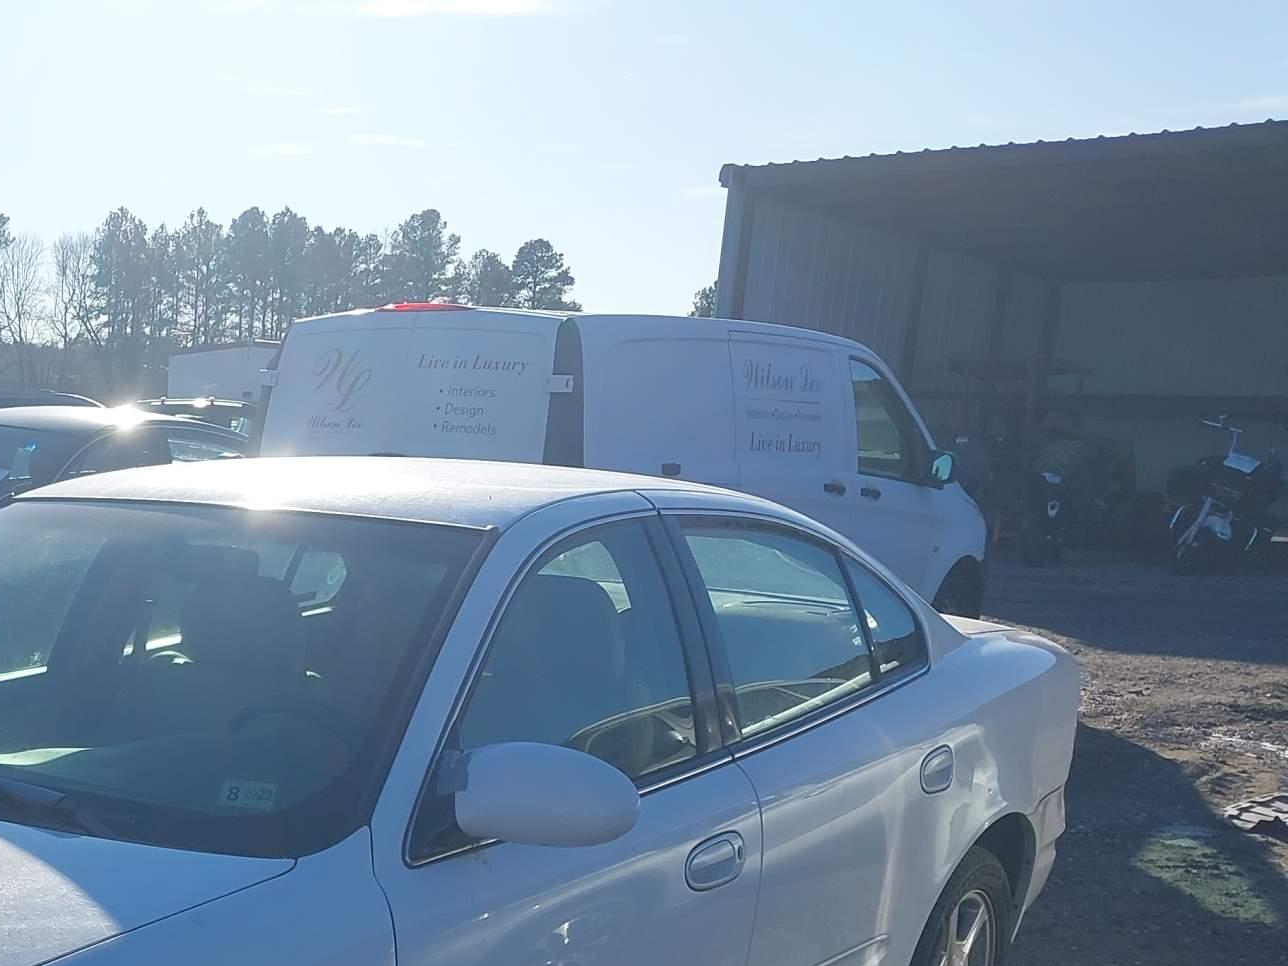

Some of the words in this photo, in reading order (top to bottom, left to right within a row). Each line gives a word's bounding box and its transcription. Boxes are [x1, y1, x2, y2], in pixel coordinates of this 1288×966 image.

[416, 354, 450, 370] Live
[452, 355, 470, 371] in
[471, 355, 529, 375] Luxury
[743, 358, 793, 391] Wilson
[447, 385, 496, 398] Interiors
[444, 402, 485, 417] Design
[441, 420, 497, 435] Remodels
[750, 431, 772, 451] Live
[775, 432, 785, 452] in
[787, 432, 822, 458] Luxury
[226, 786, 240, 801] 8
